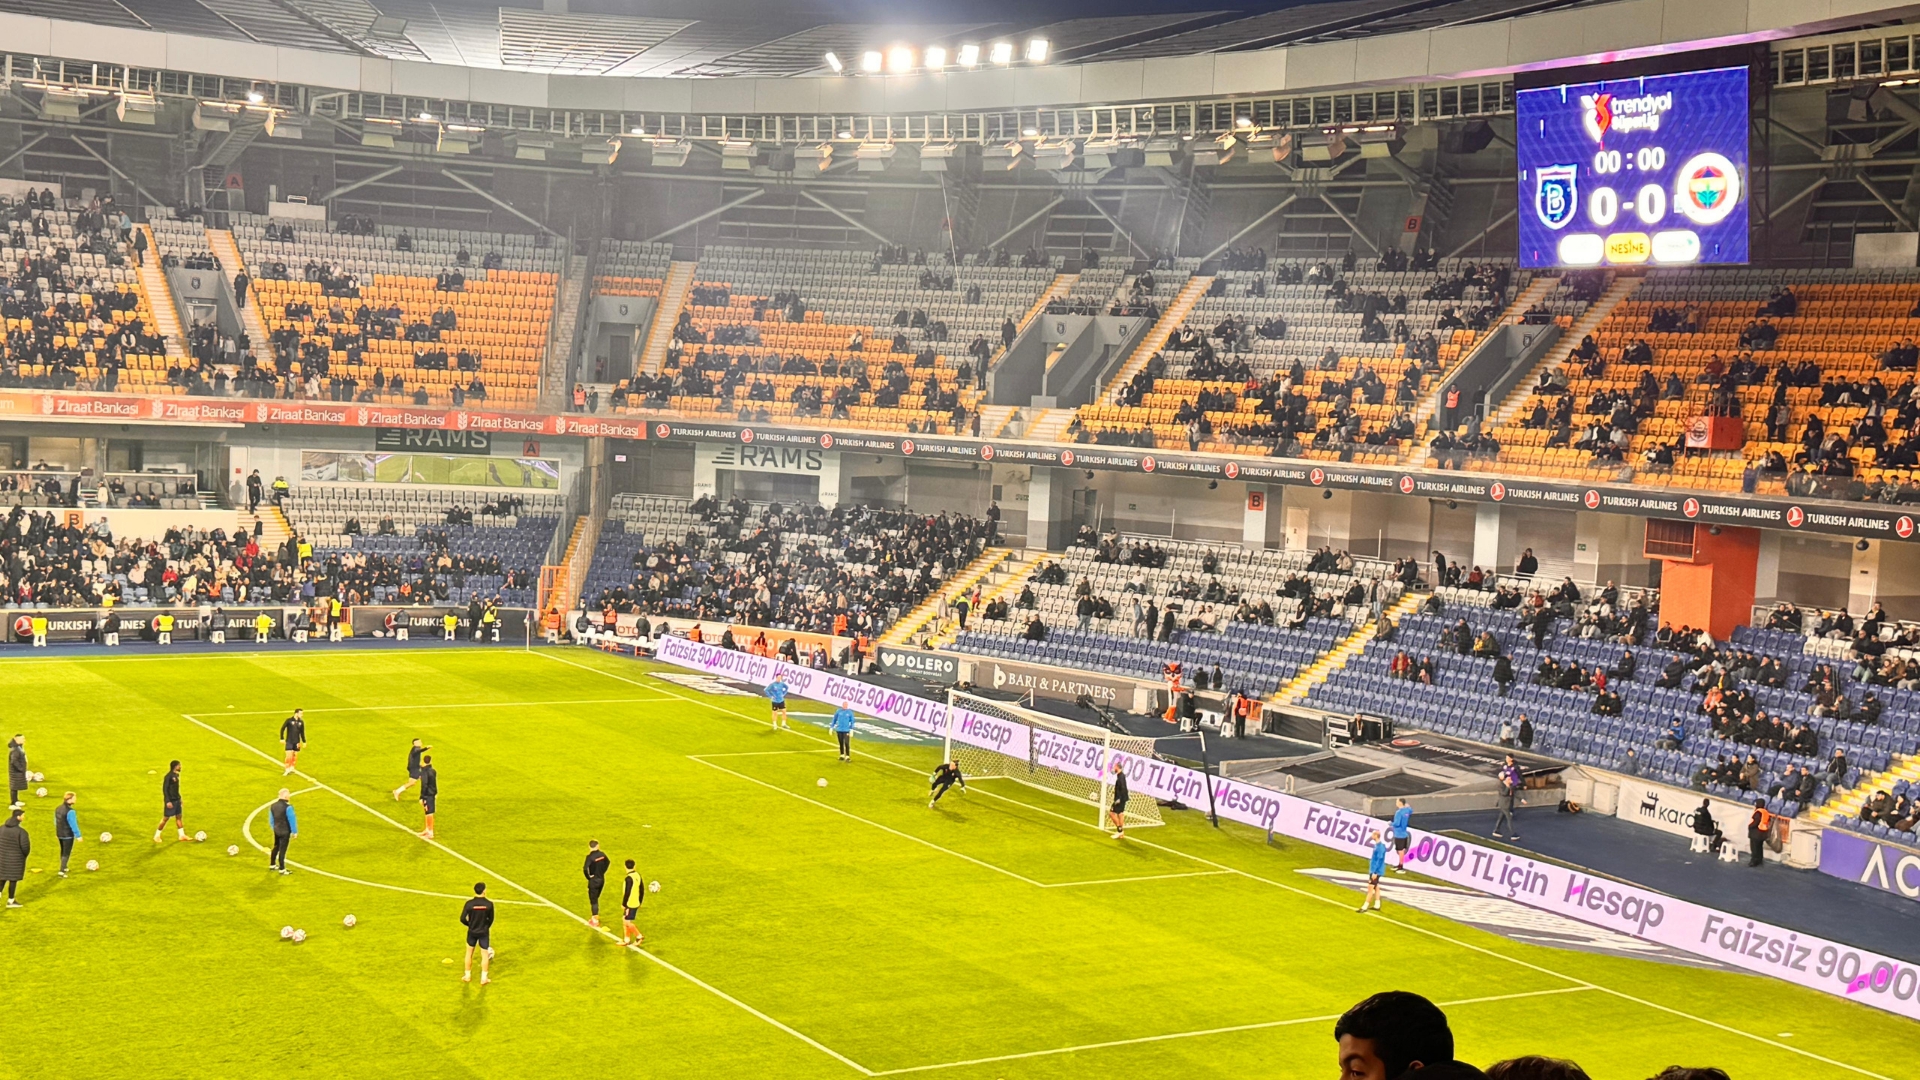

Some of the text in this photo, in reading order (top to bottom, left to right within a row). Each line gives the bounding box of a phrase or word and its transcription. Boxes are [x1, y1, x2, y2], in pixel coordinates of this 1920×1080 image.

[1611, 91, 1672, 114] trendyol
[231, 176, 240, 186] A
[1408, 218, 1417, 229] B
[406, 429, 487, 448] RAMS
[673, 428, 736, 438] TURKISH AIRLINES
[756, 433, 816, 443] TURKISH AIRLINES
[526, 444, 536, 455] A
[835, 438, 895, 449] TURKISH AIRLINES
[916, 444, 976, 455] TURKISH AIRLINES
[741, 445, 822, 471] RAMS
[996, 449, 1056, 461] TURKISH AIRLINES
[1076, 455, 1138, 466] TURKISH AIRLINES
[1157, 461, 1220, 473] TURKISH AIRLINES
[1241, 467, 1305, 479] TURKISH AIRLINES
[1326, 473, 1393, 486] TURKISH AIRLINES
[1416, 481, 1485, 495] TURKISH AIRLINES
[1252, 495, 1261, 507] B
[1508, 488, 1579, 503] TURKISH AIRLINES
[1603, 496, 1677, 511] TURKISH AIRLINES
[1702, 504, 1781, 520] TURKISH AIRLINES
[69, 513, 80, 525] B
[1807, 514, 1890, 530] TURKISH AIRLINES
[48, 620, 92, 630] URKISH
[664, 638, 697, 662] Faizsiz
[772, 662, 812, 693] Hesap
[897, 654, 954, 673] BOLERO
[1009, 673, 1116, 700] BARI & PARTNERS
[823, 677, 866, 705] Faizsiz
[913, 700, 927, 723] TL
[961, 712, 1012, 750] Hesap
[1147, 763, 1165, 790] TL
[1166, 767, 1202, 800] için
[1215, 780, 1280, 826] Hesap
[1471, 850, 1494, 882] TL
[1499, 855, 1549, 897] için
[1563, 873, 1664, 935] Hesap
[1700, 914, 1920, 1005] Faizsiz 90.00
